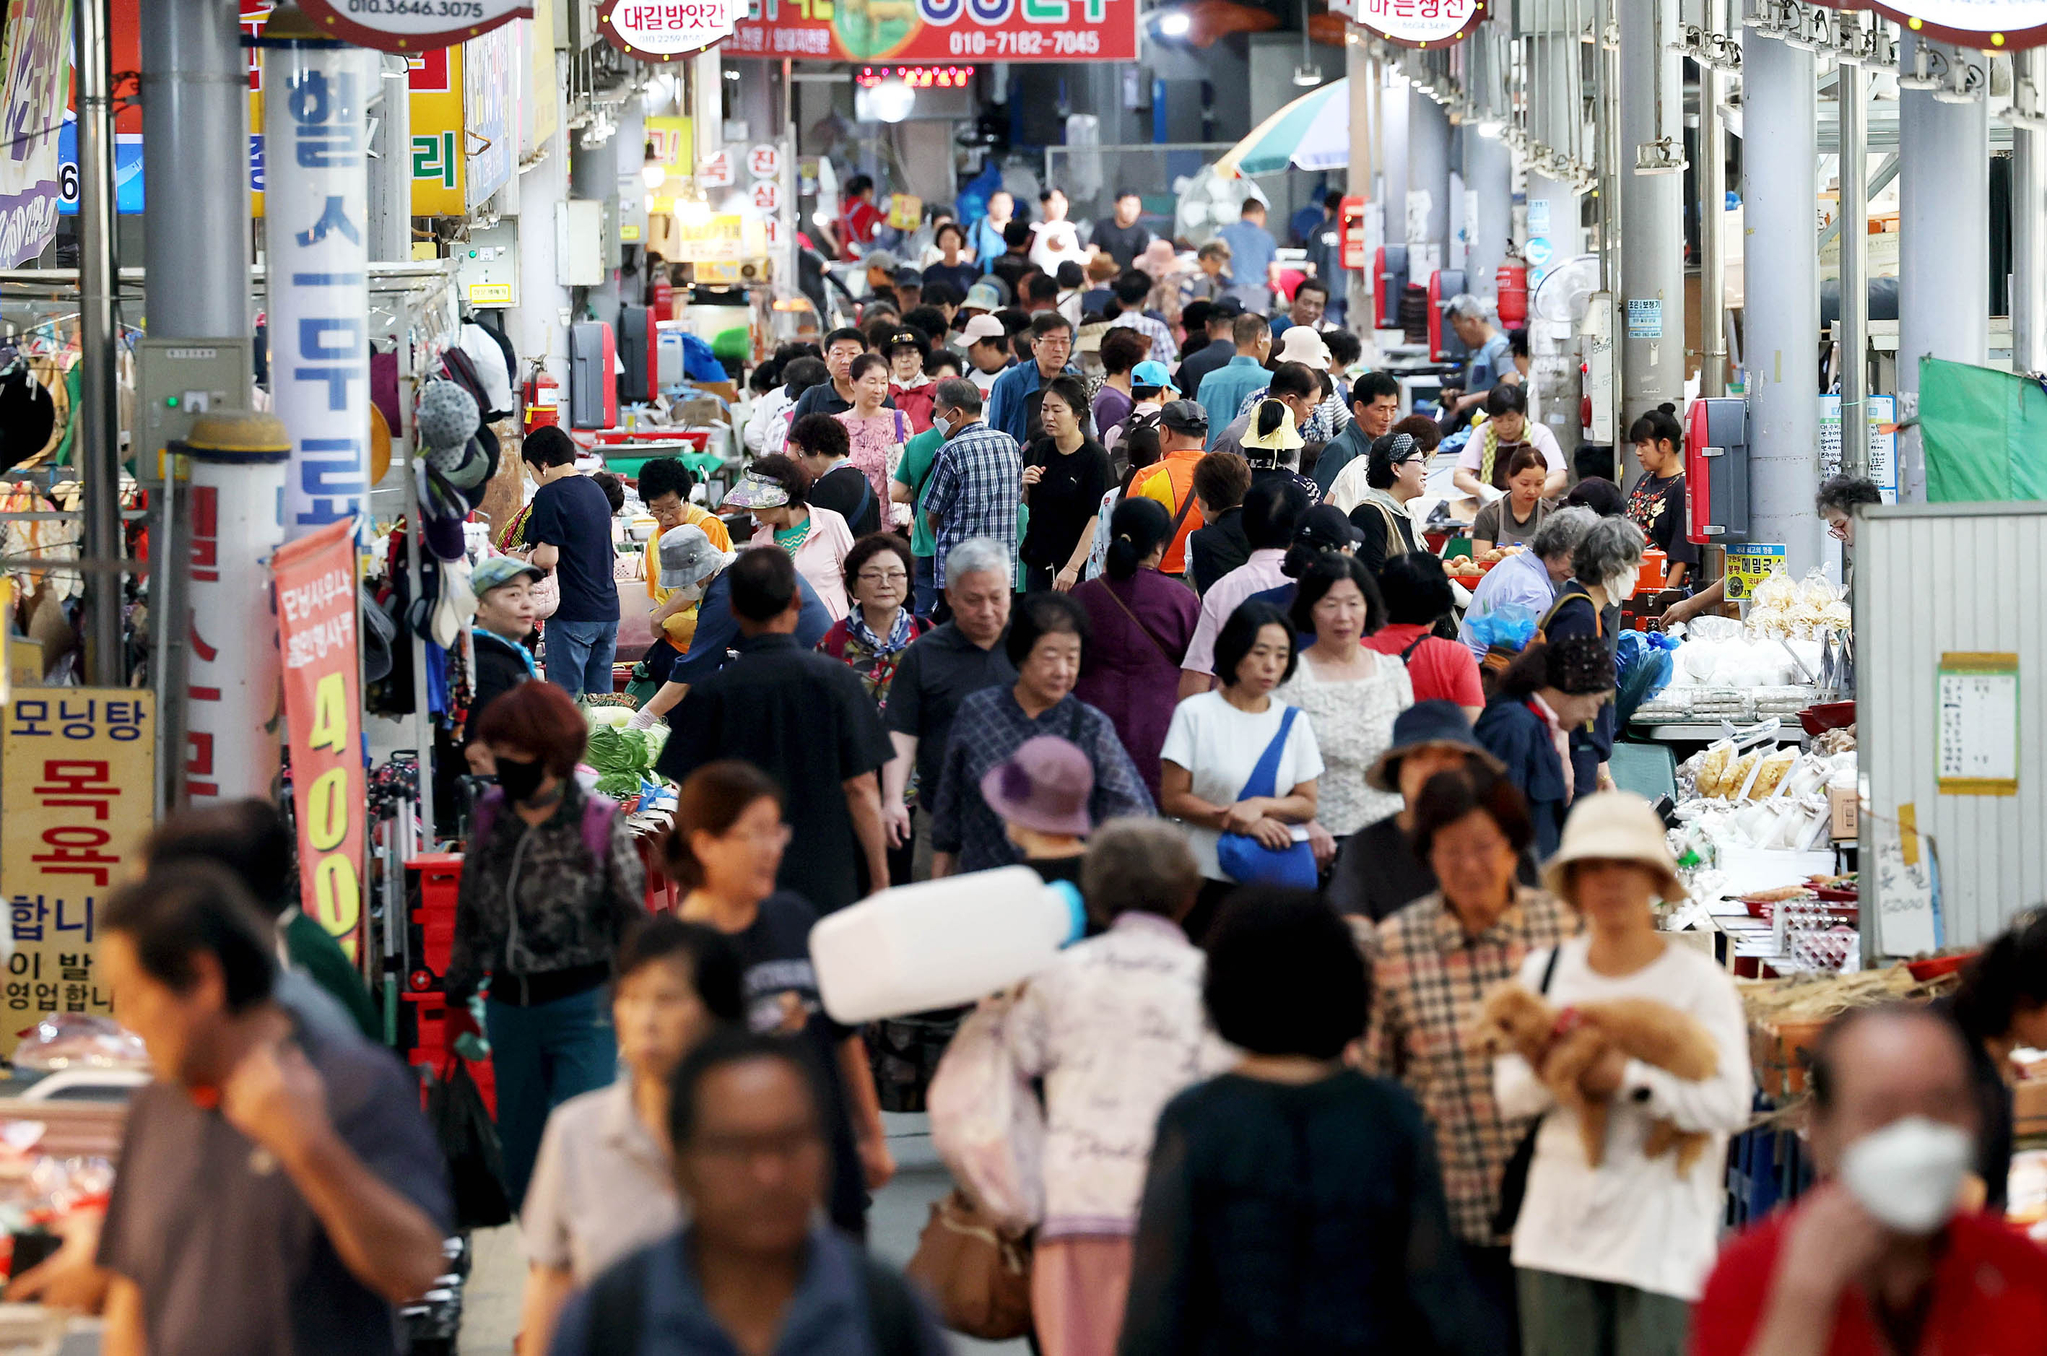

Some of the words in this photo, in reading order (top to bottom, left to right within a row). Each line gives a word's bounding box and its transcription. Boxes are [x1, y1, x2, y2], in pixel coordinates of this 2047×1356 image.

[348, 0, 483, 17] 010.3646.3075
[624, 3, 725, 31] 대길방앗간
[949, 30, 1100, 54] 010-7182-7045
[10, 699, 146, 741] 모닝탕
[31, 760, 121, 886] 목욕
[308, 670, 361, 967] 400
[10, 895, 94, 943] 합니
[7, 982, 115, 1013] 영업합니
